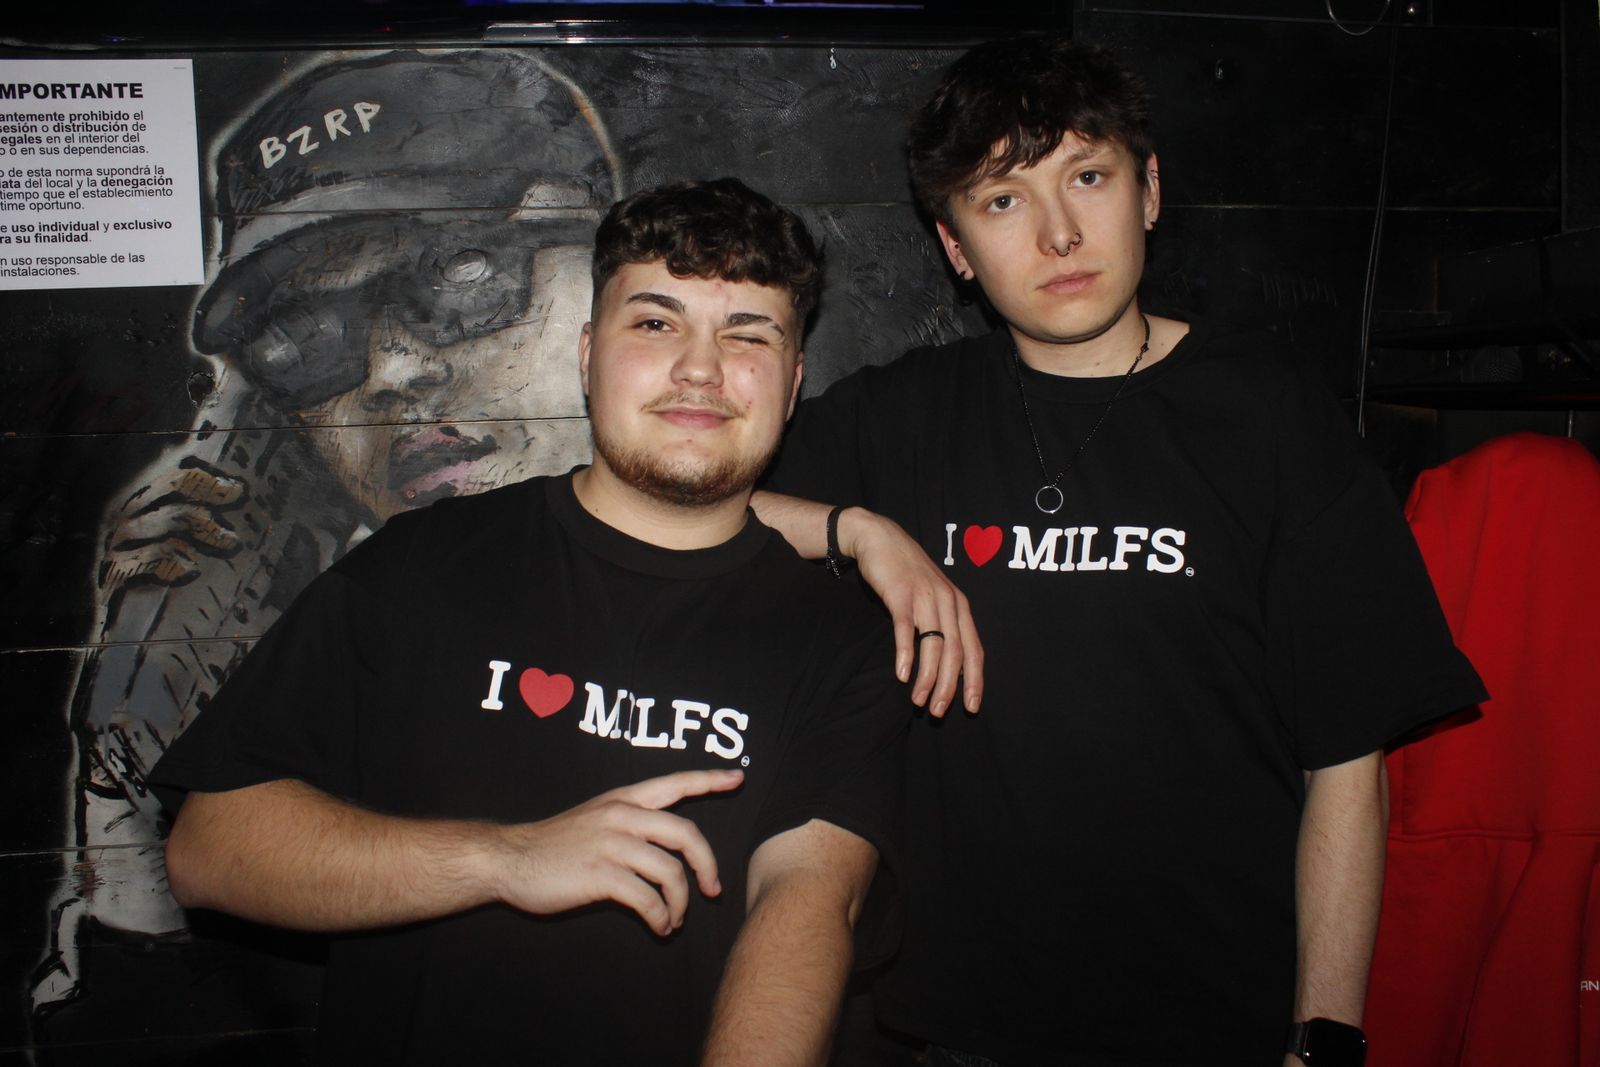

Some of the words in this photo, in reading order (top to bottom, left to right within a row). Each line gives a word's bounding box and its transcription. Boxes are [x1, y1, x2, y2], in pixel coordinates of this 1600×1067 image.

[0, 83, 143, 99] MPORTANTE
[0, 112, 65, 123] antemente
[69, 110, 130, 124] prohibido
[133, 110, 144, 121] el
[41, 125, 49, 133] o
[53, 121, 128, 133] distribución
[132, 121, 147, 132] de
[2, 134, 42, 147] egales
[46, 135, 60, 144] en
[65, 133, 74, 144] el
[79, 132, 119, 144] interior
[122, 132, 140, 143] del
[260, 101, 380, 169] BZRP
[9, 147, 17, 155] o
[21, 147, 35, 155] en
[39, 146, 60, 155] sus
[63, 143, 149, 157] dependencias.
[8, 167, 23, 177] de
[27, 167, 52, 178] esta
[56, 168, 93, 177] norma
[96, 164, 151, 178] supondrá
[154, 165, 165, 175] la
[25, 178, 42, 188] del
[46, 178, 73, 188] local
[77, 179, 83, 190] y
[87, 177, 97, 187] la
[101, 175, 173, 189] denegación
[0, 190, 40, 202] tiempo
[43, 190, 65, 201] que
[69, 189, 79, 199] el
[82, 187, 173, 199] establecimiento
[0, 201, 26, 211] time
[29, 200, 85, 212] oportuno.
[0, 224, 8, 232] e
[11, 224, 35, 233] uso
[38, 220, 99, 232] individual
[103, 222, 110, 234] y
[113, 219, 172, 230] exclusivo
[15, 235, 31, 244] su
[34, 232, 92, 244] finalidad.
[0, 258, 7, 266] n
[11, 257, 33, 266] uso
[36, 253, 107, 267] responsable
[110, 253, 125, 263] de
[128, 252, 146, 263] las
[0, 266, 80, 277] instalaciones.
[943, 523, 958, 566] I
[1008, 525, 1186, 574] MILFS
[481, 660, 511, 711] I
[578, 681, 749, 760] MILFS
